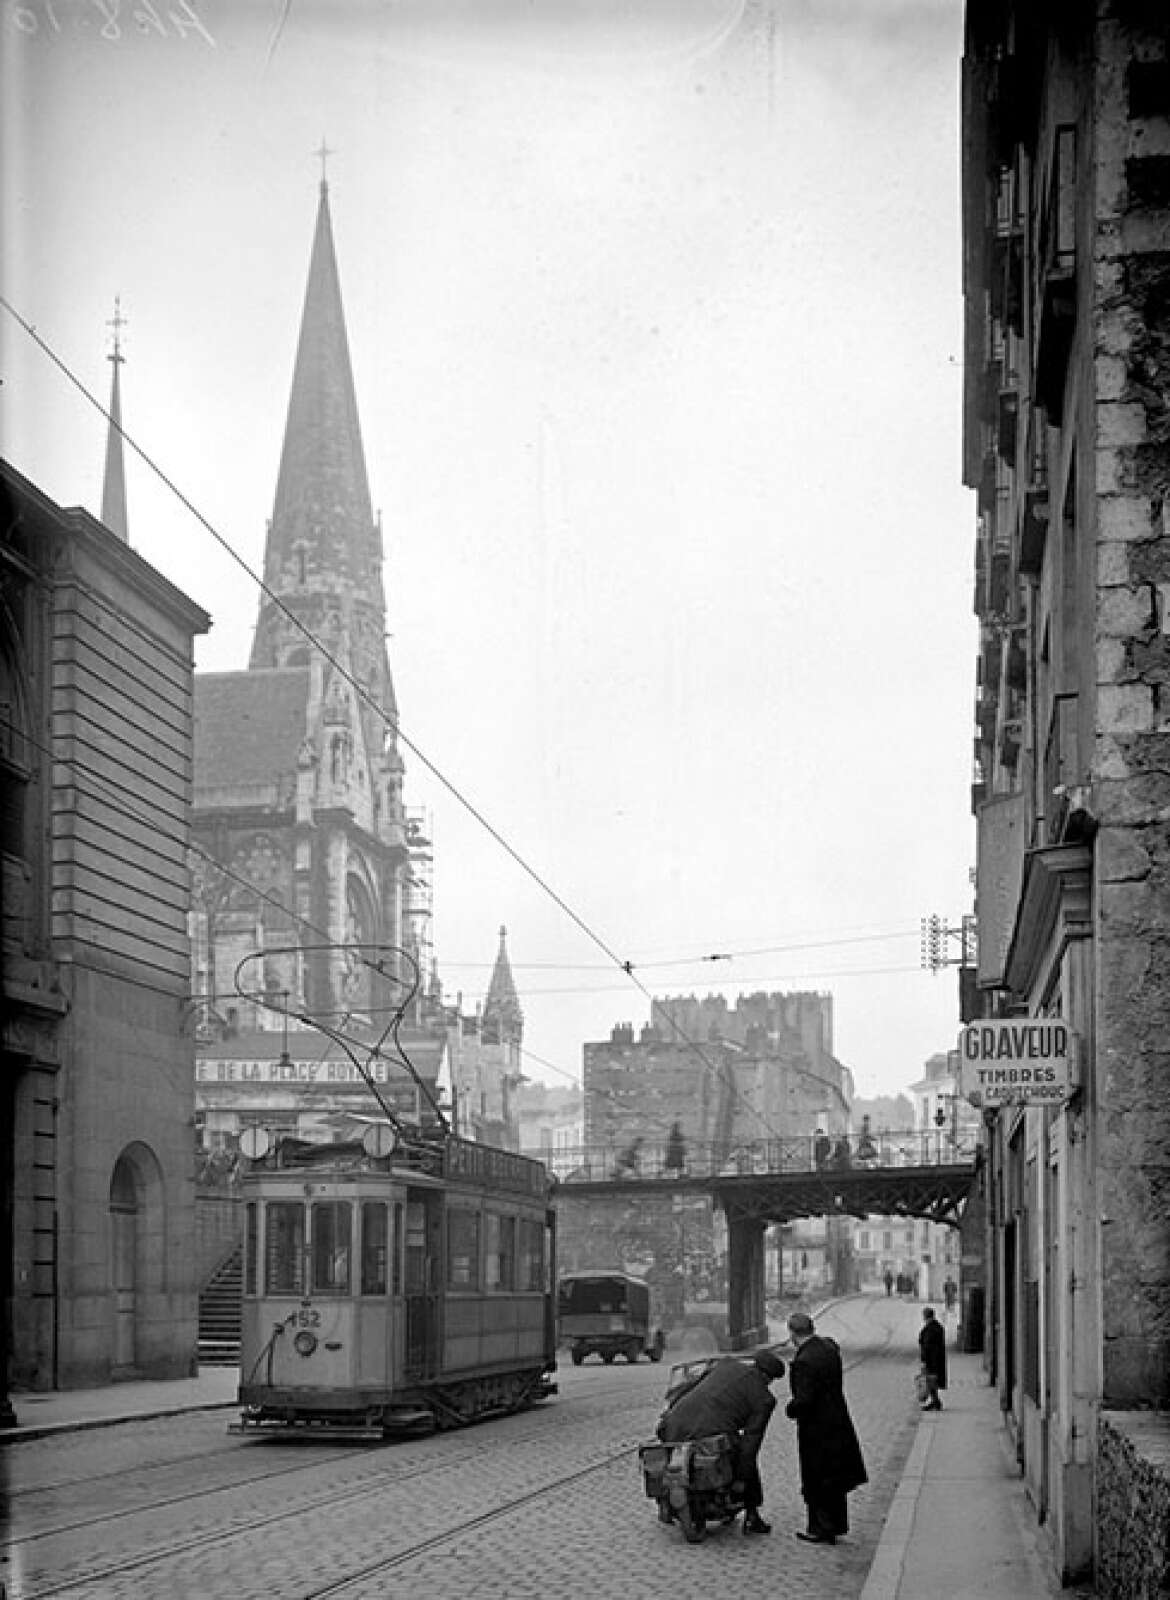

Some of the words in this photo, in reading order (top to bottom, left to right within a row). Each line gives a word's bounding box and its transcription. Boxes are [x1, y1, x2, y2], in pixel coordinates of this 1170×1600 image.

[966, 1025, 1067, 1060] GRAVEUR
[217, 1063, 236, 1081] DE
[241, 1063, 261, 1081] LA
[270, 1063, 317, 1081] PLACE
[327, 1063, 384, 1081] ROYE
[976, 1067, 1056, 1083] TIMBRES
